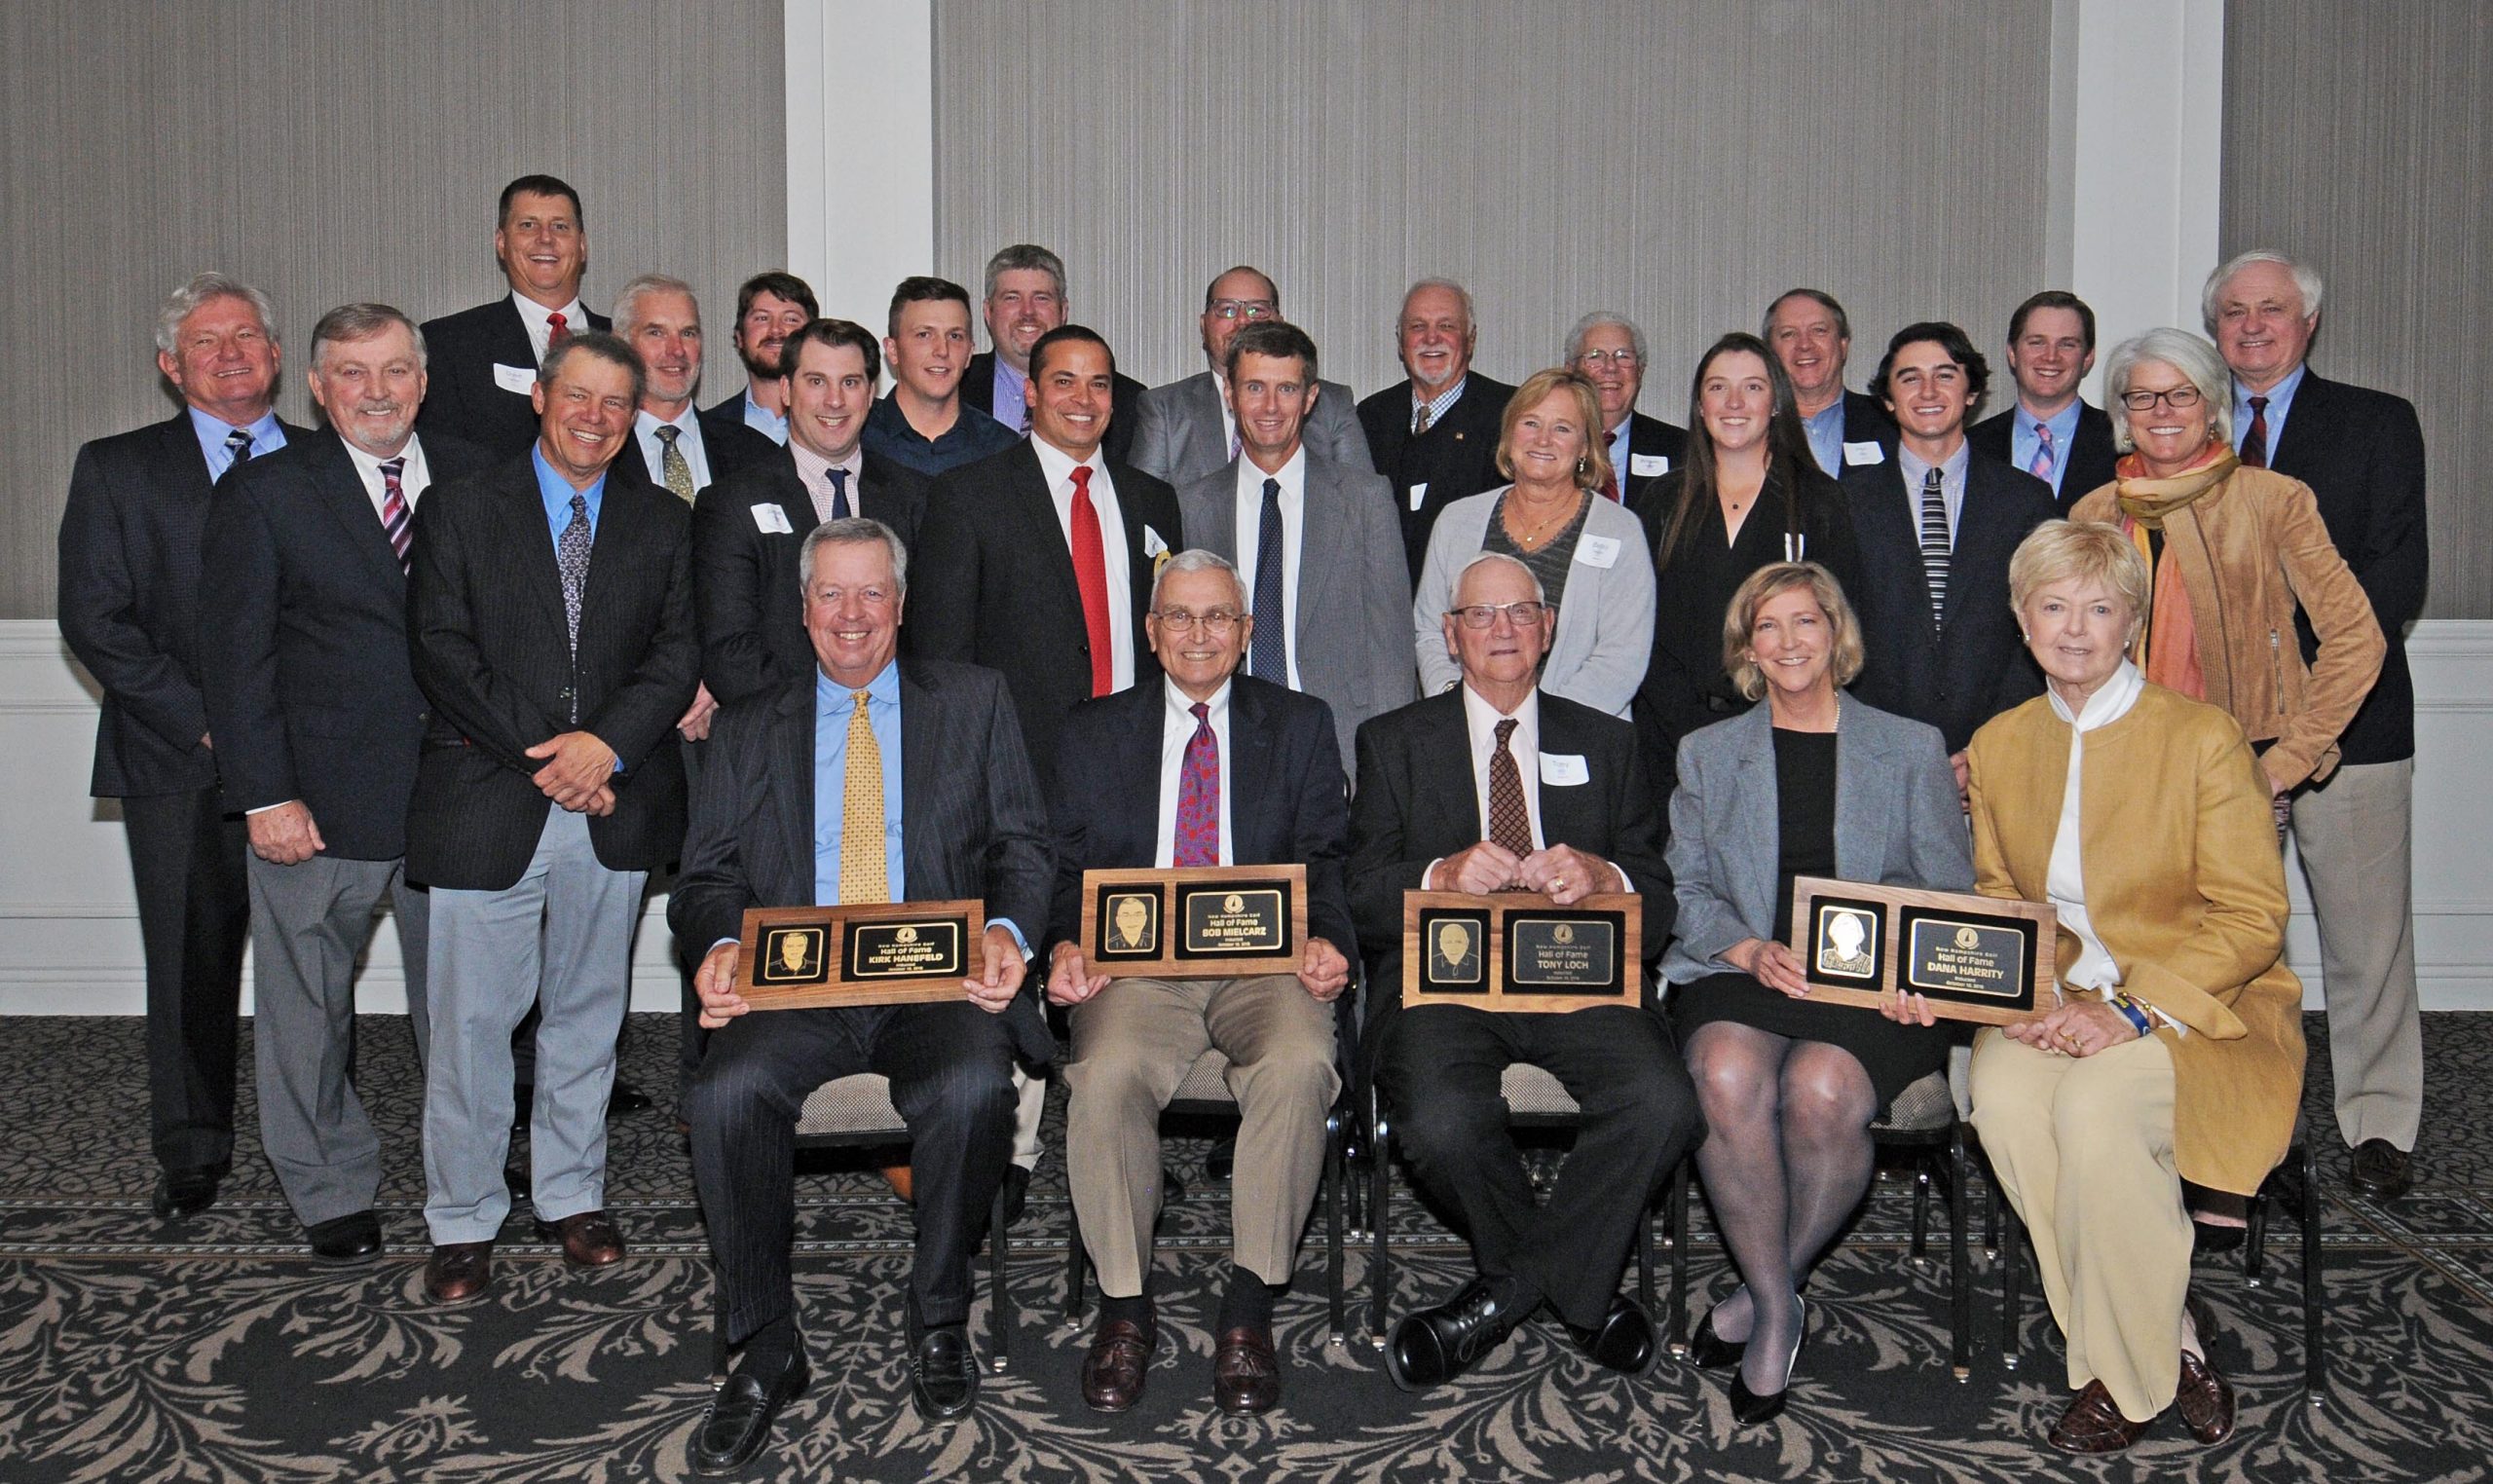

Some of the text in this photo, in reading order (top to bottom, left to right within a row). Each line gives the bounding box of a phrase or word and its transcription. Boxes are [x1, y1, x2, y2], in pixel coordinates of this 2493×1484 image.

[1223, 927, 1266, 936] MIELCARZ
[893, 953, 944, 962] HANEFELD
[1938, 953, 1955, 962] Hall
[1969, 956, 1994, 967] Fame
[1927, 962, 2003, 979] DANA HARRITY
